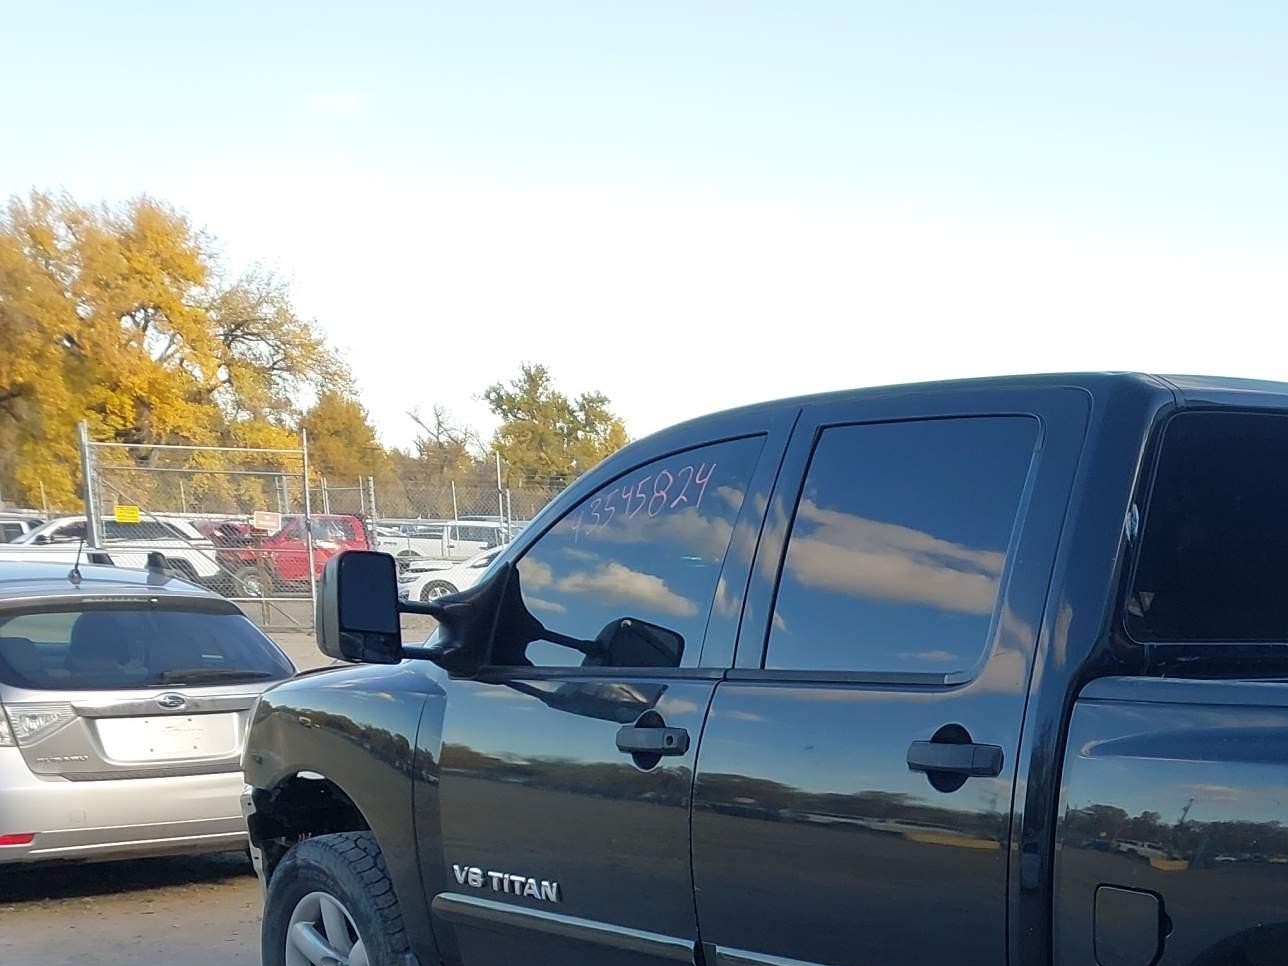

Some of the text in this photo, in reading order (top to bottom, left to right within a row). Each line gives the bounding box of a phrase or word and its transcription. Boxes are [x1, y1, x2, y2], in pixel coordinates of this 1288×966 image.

[572, 463, 717, 544] 43545824
[453, 864, 558, 903] V8 TITAN
